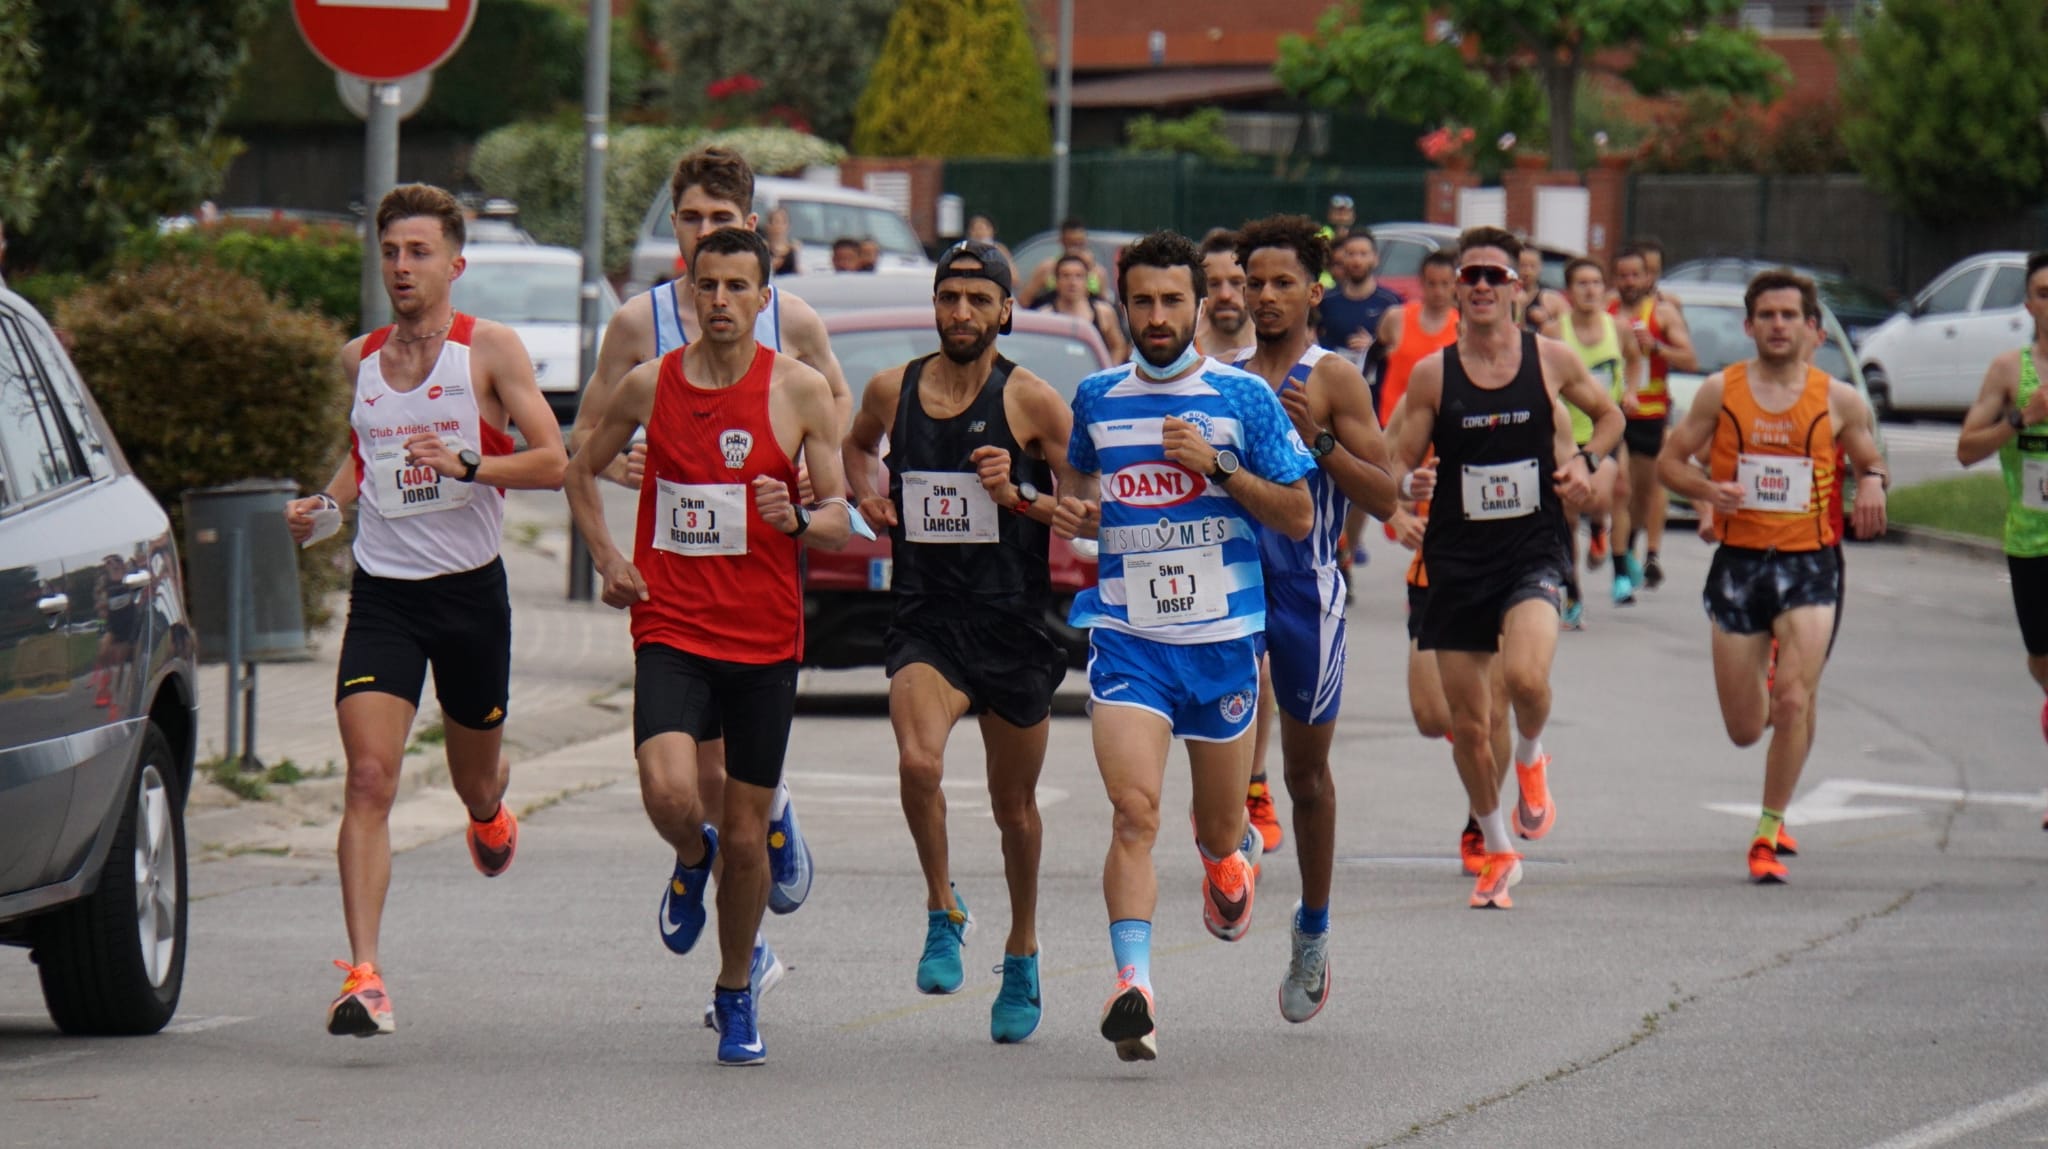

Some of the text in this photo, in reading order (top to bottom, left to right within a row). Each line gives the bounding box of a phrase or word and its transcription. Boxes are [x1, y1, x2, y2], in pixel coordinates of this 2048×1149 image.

[369, 427, 393, 439] Club
[433, 420, 460, 433] TMB
[933, 484, 957, 497] 5km
[1117, 472, 1185, 498] DANI
[402, 485, 440, 505] JORDI
[680, 497, 705, 509] 5km
[1481, 498, 1521, 512] CARLOS
[923, 517, 971, 533] LAHCEN
[1180, 517, 1226, 546] MÉS
[670, 527, 720, 545] REDOUAN
[1159, 564, 1185, 577] 5km
[1156, 596, 1195, 614] JOSEP
